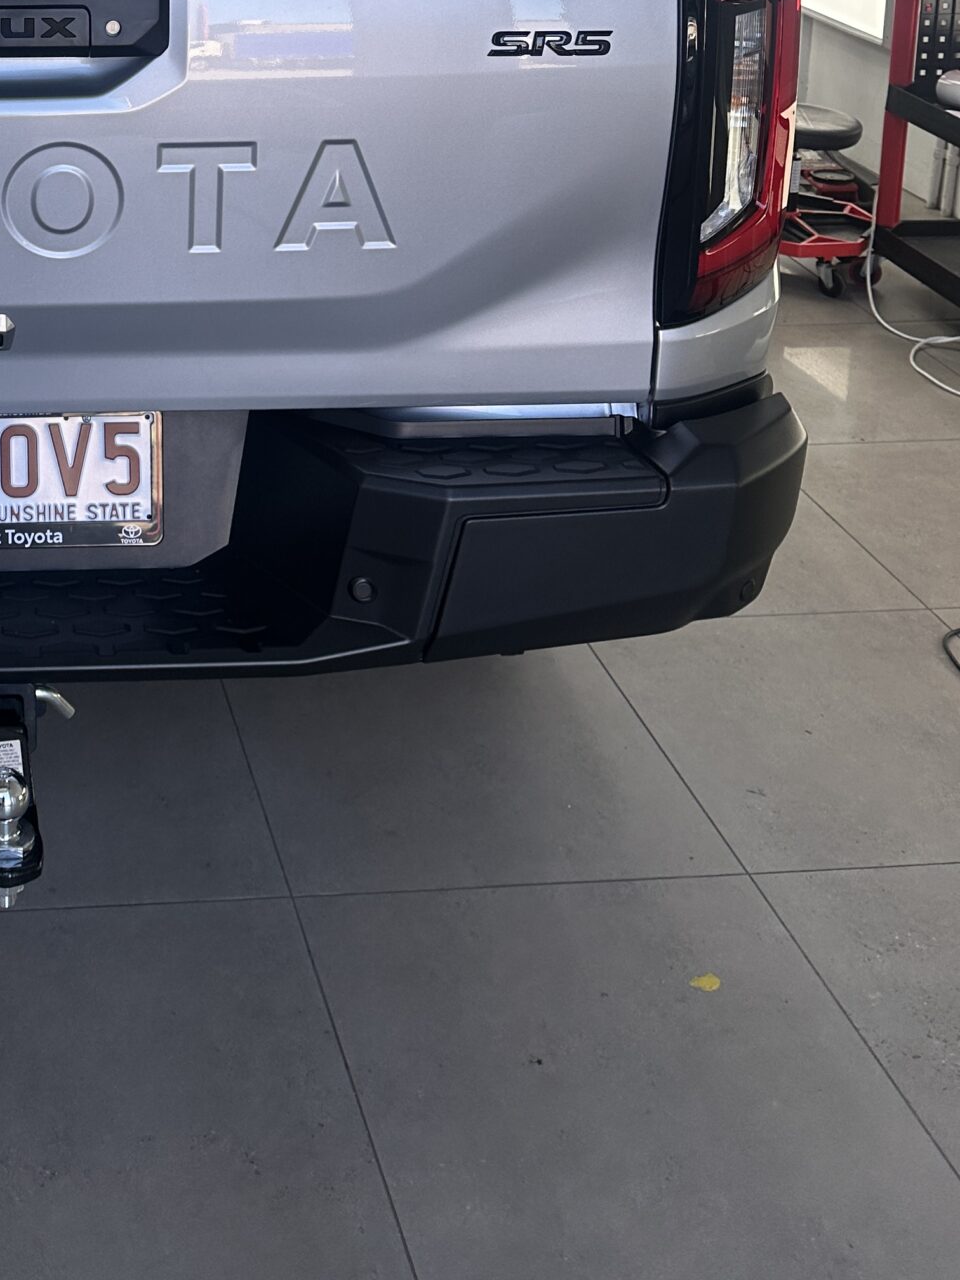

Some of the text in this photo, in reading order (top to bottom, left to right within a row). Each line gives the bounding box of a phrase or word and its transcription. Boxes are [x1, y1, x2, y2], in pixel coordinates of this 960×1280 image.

[487, 30, 613, 57] SR5
[86, 502, 141, 521] STATE
[5, 529, 63, 548] Toyota
